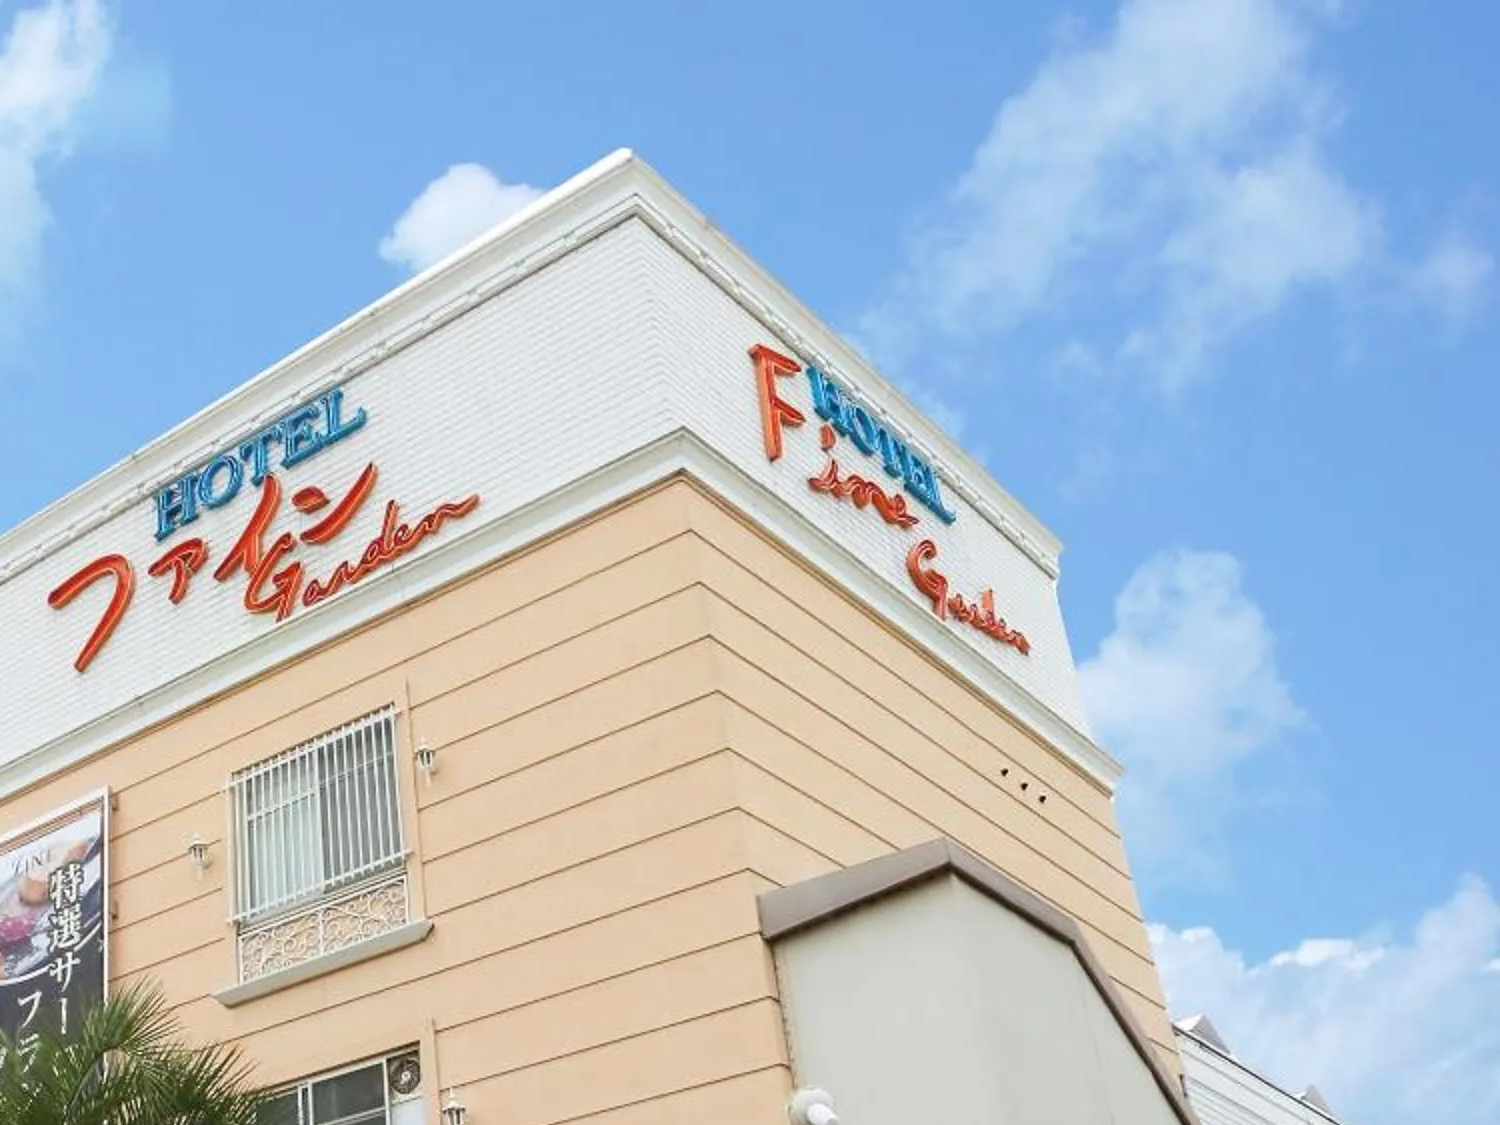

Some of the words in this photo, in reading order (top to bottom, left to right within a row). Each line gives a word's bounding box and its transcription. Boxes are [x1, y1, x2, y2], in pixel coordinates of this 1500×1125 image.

[154, 384, 368, 542] HOTEL
[46, 461, 379, 674] ファイン
[244, 493, 481, 623] Garden
[48, 862, 84, 1075] 特選サー
